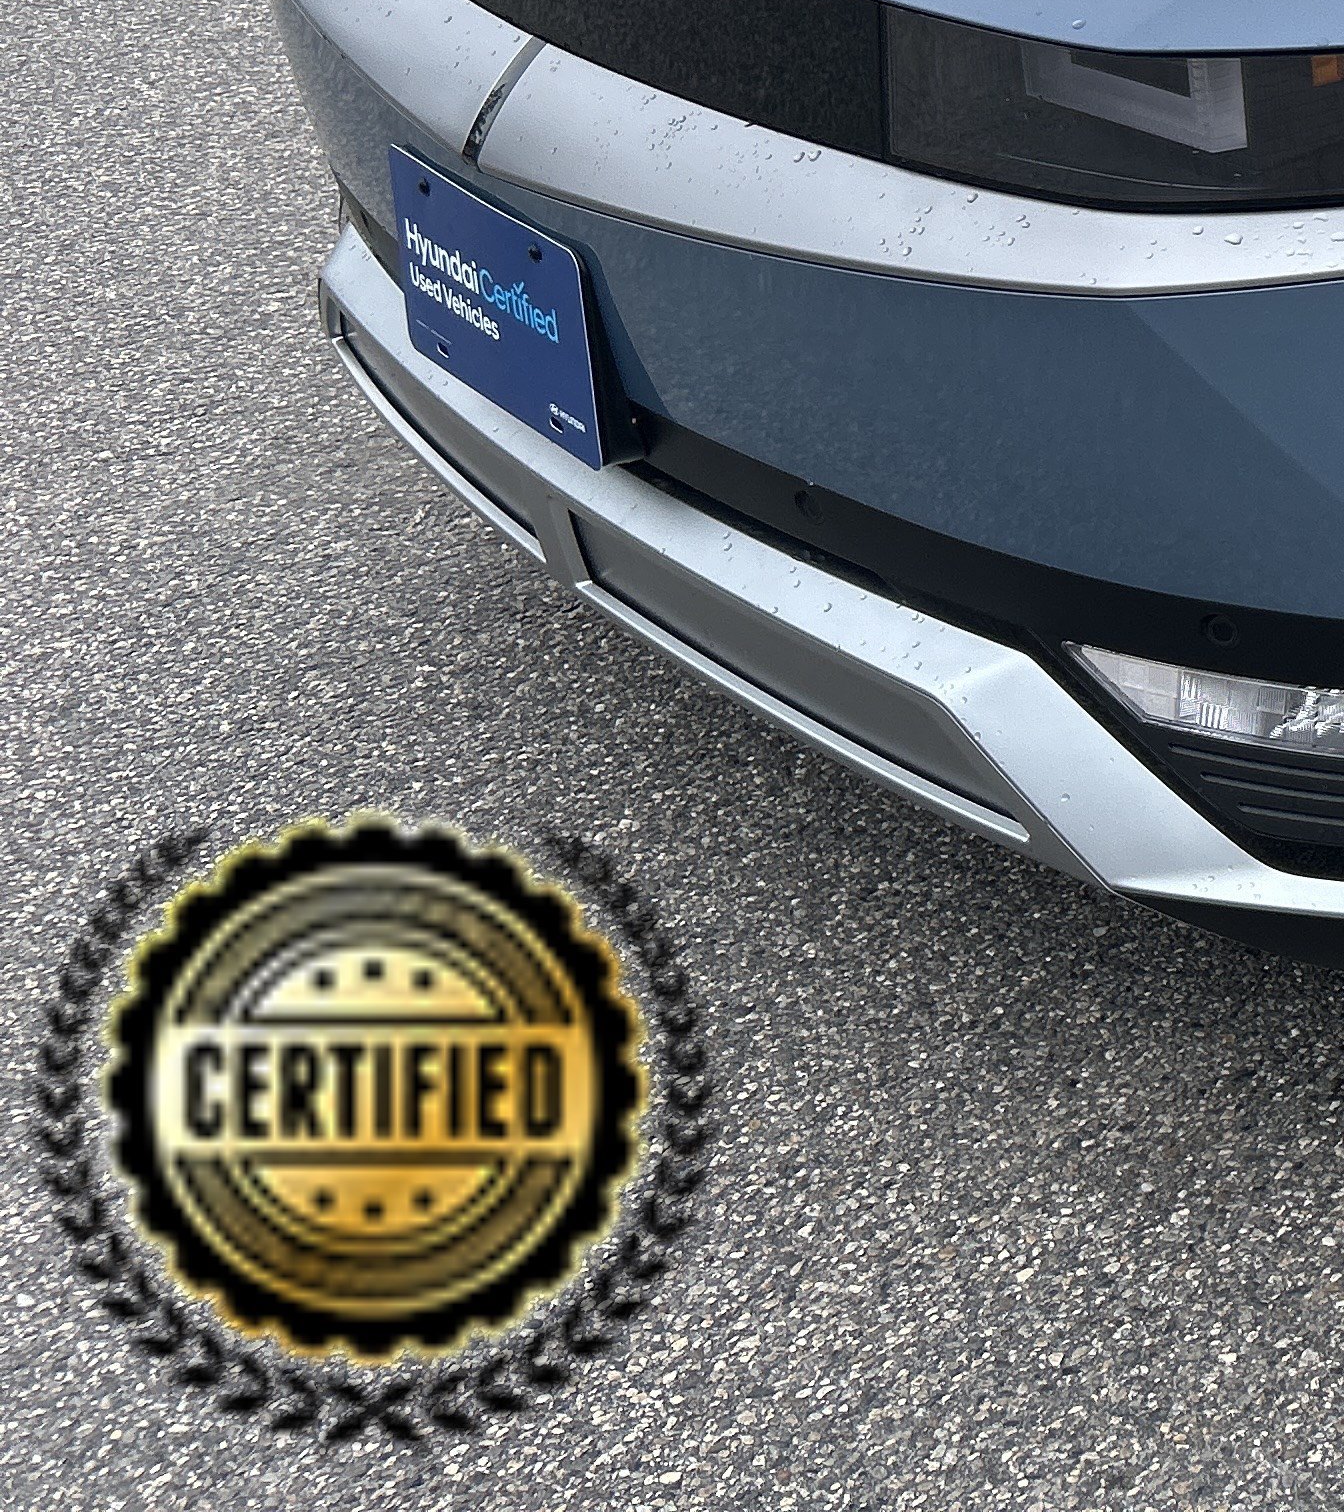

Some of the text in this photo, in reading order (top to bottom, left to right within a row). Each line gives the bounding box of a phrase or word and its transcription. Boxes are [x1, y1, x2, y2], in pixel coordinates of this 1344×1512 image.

[404, 217, 560, 344] Hyundai Certified
[409, 261, 443, 304] Used
[442, 286, 501, 341] Vehicles
